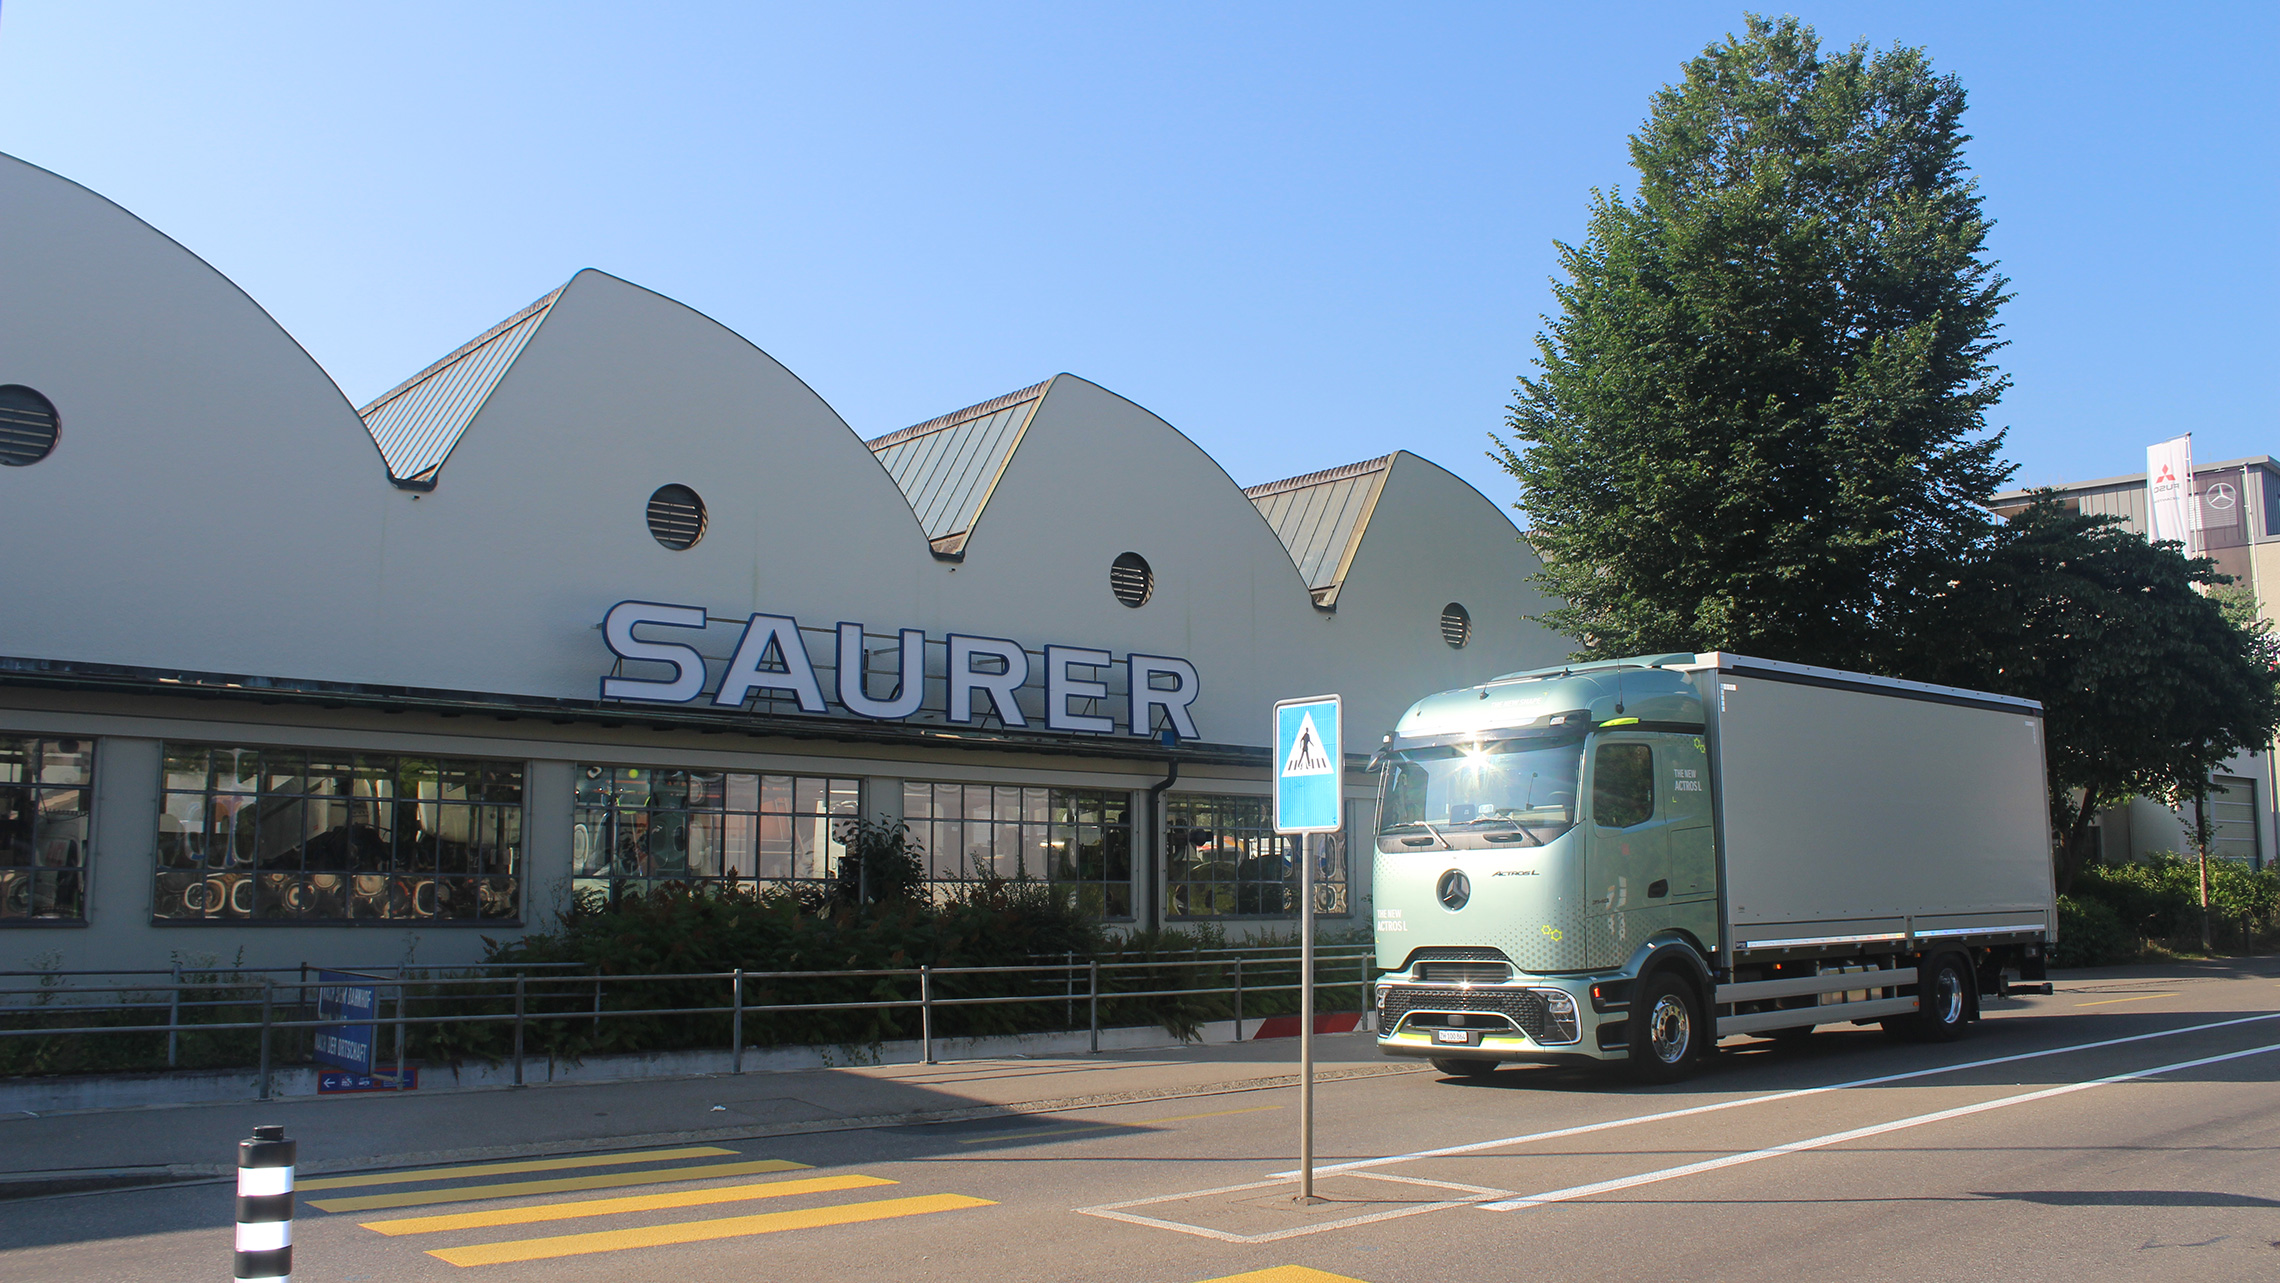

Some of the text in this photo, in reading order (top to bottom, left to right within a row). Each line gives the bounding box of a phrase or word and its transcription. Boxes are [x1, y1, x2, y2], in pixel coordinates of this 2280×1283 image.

[600, 600, 1201, 739] SAURER
[1674, 769, 1697, 778] THE NEW
[1675, 780, 1702, 791] ACTROS L
[1377, 909, 1402, 918] THE NEW
[1377, 920, 1408, 932] ACTROS L
[315, 1032, 367, 1063] NACH DER ORTSCHAFT
